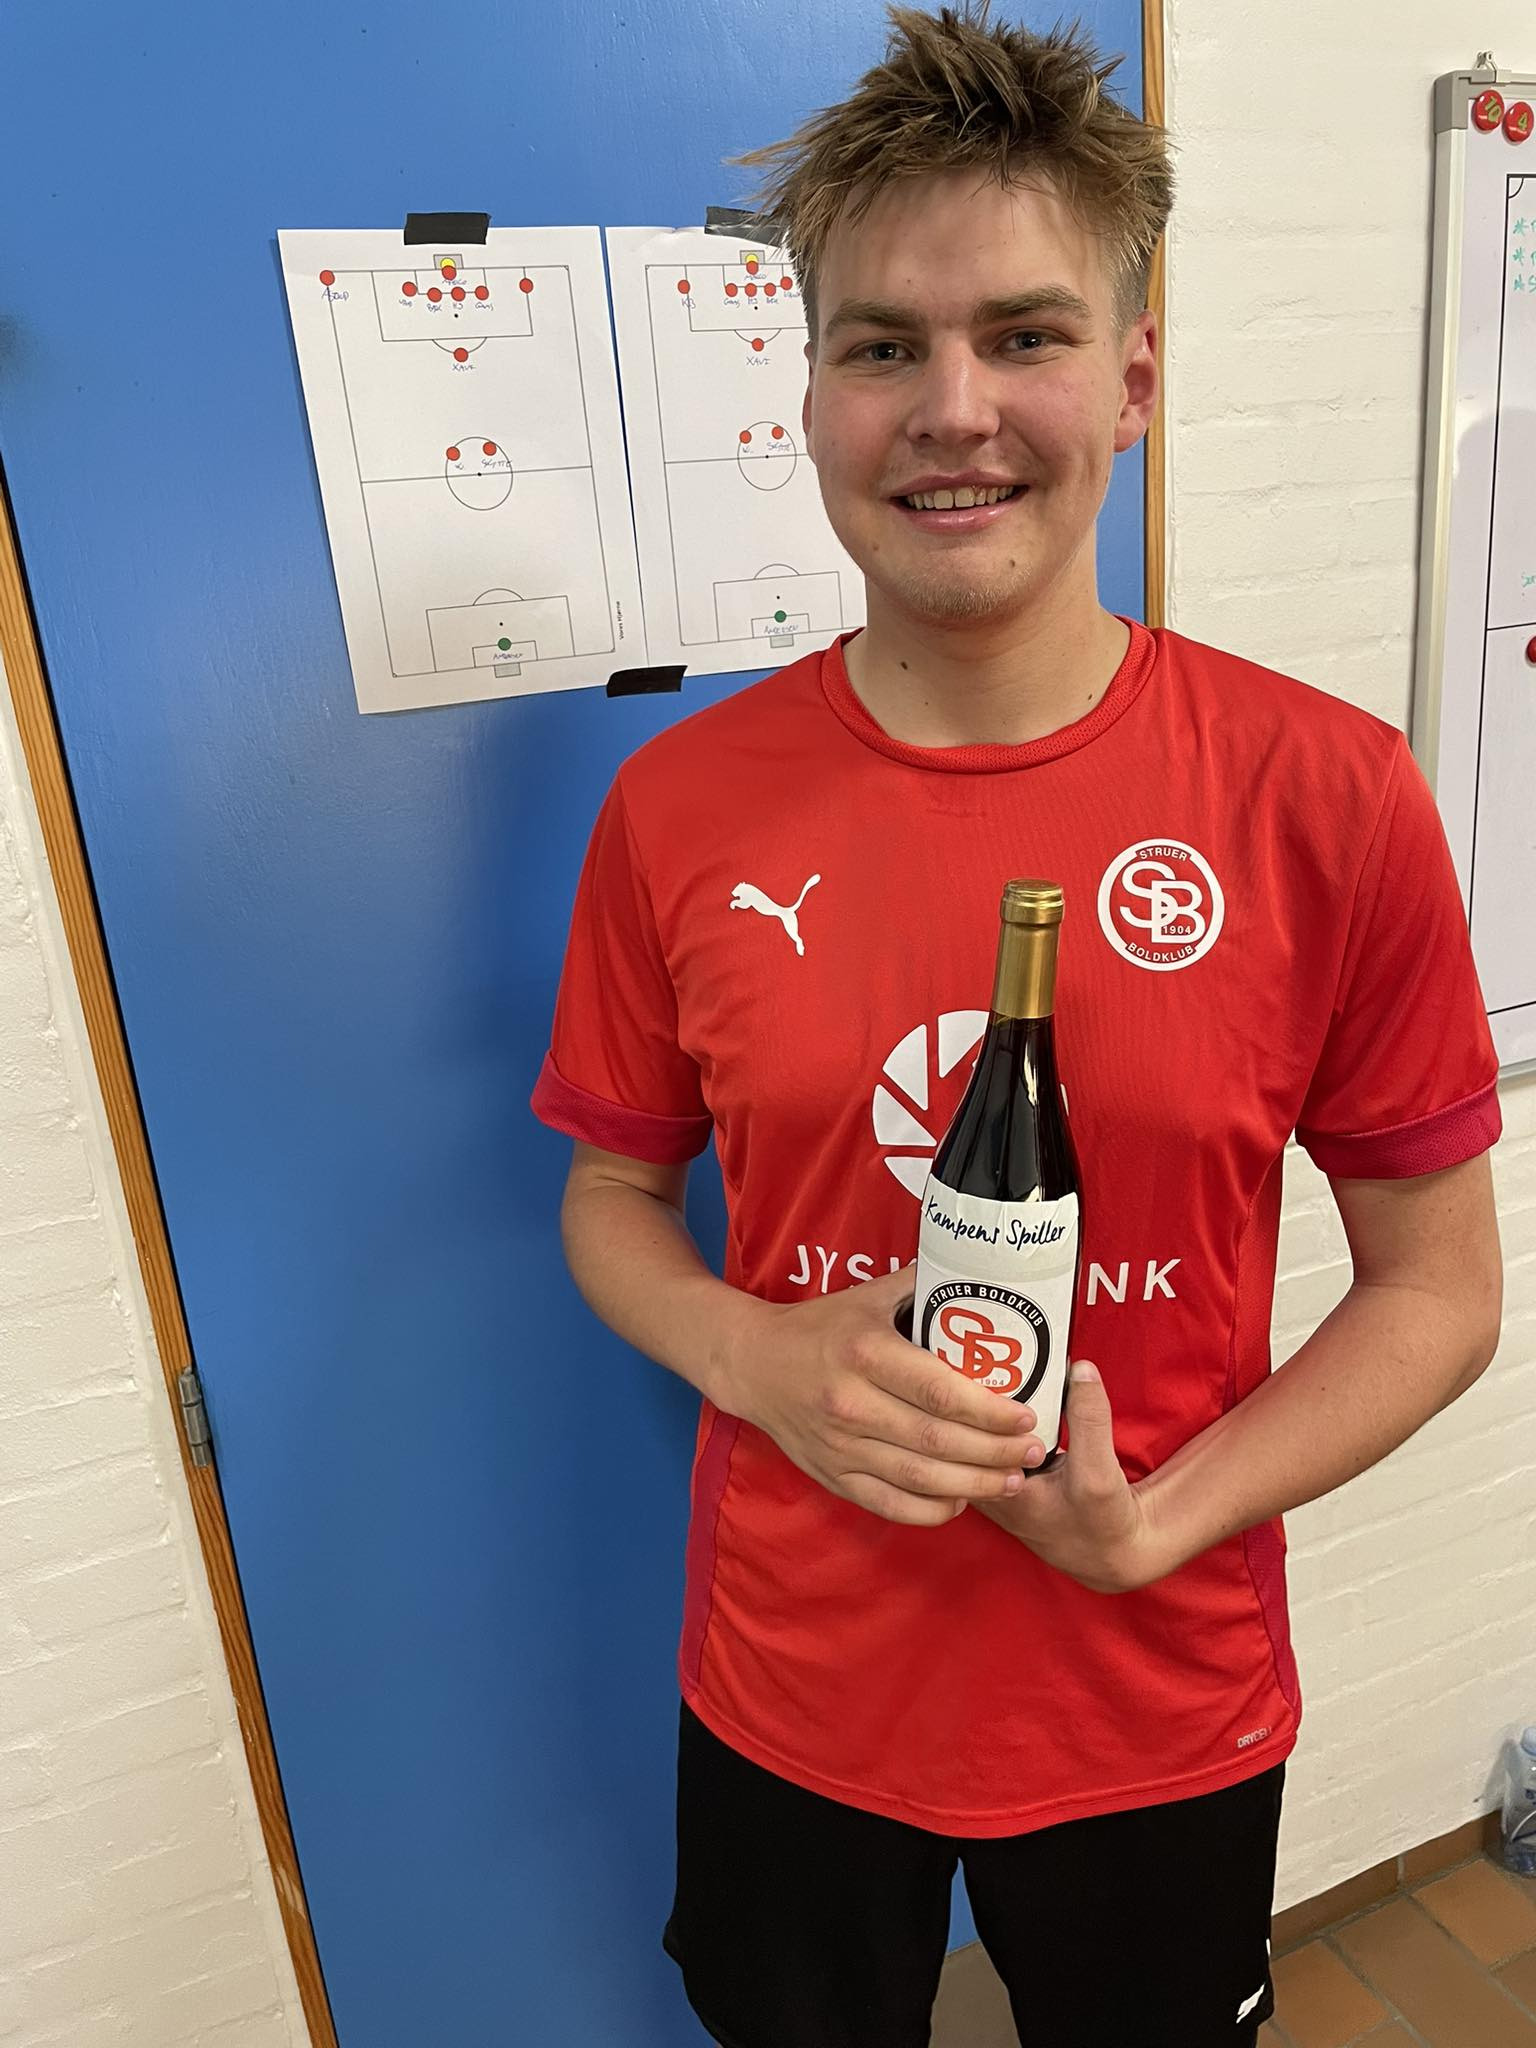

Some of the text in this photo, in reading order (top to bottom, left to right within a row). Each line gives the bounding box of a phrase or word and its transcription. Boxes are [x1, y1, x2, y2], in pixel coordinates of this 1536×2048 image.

[1517, 112, 1528, 131] 4
[1139, 847, 1188, 861] STRUER
[1163, 925, 1191, 934] 1904
[1128, 942, 1194, 962] BOLDKLUB
[925, 1195, 1067, 1251] Kampens Spiller
[931, 1284, 1043, 1327] STRUER BOLDKLUB
